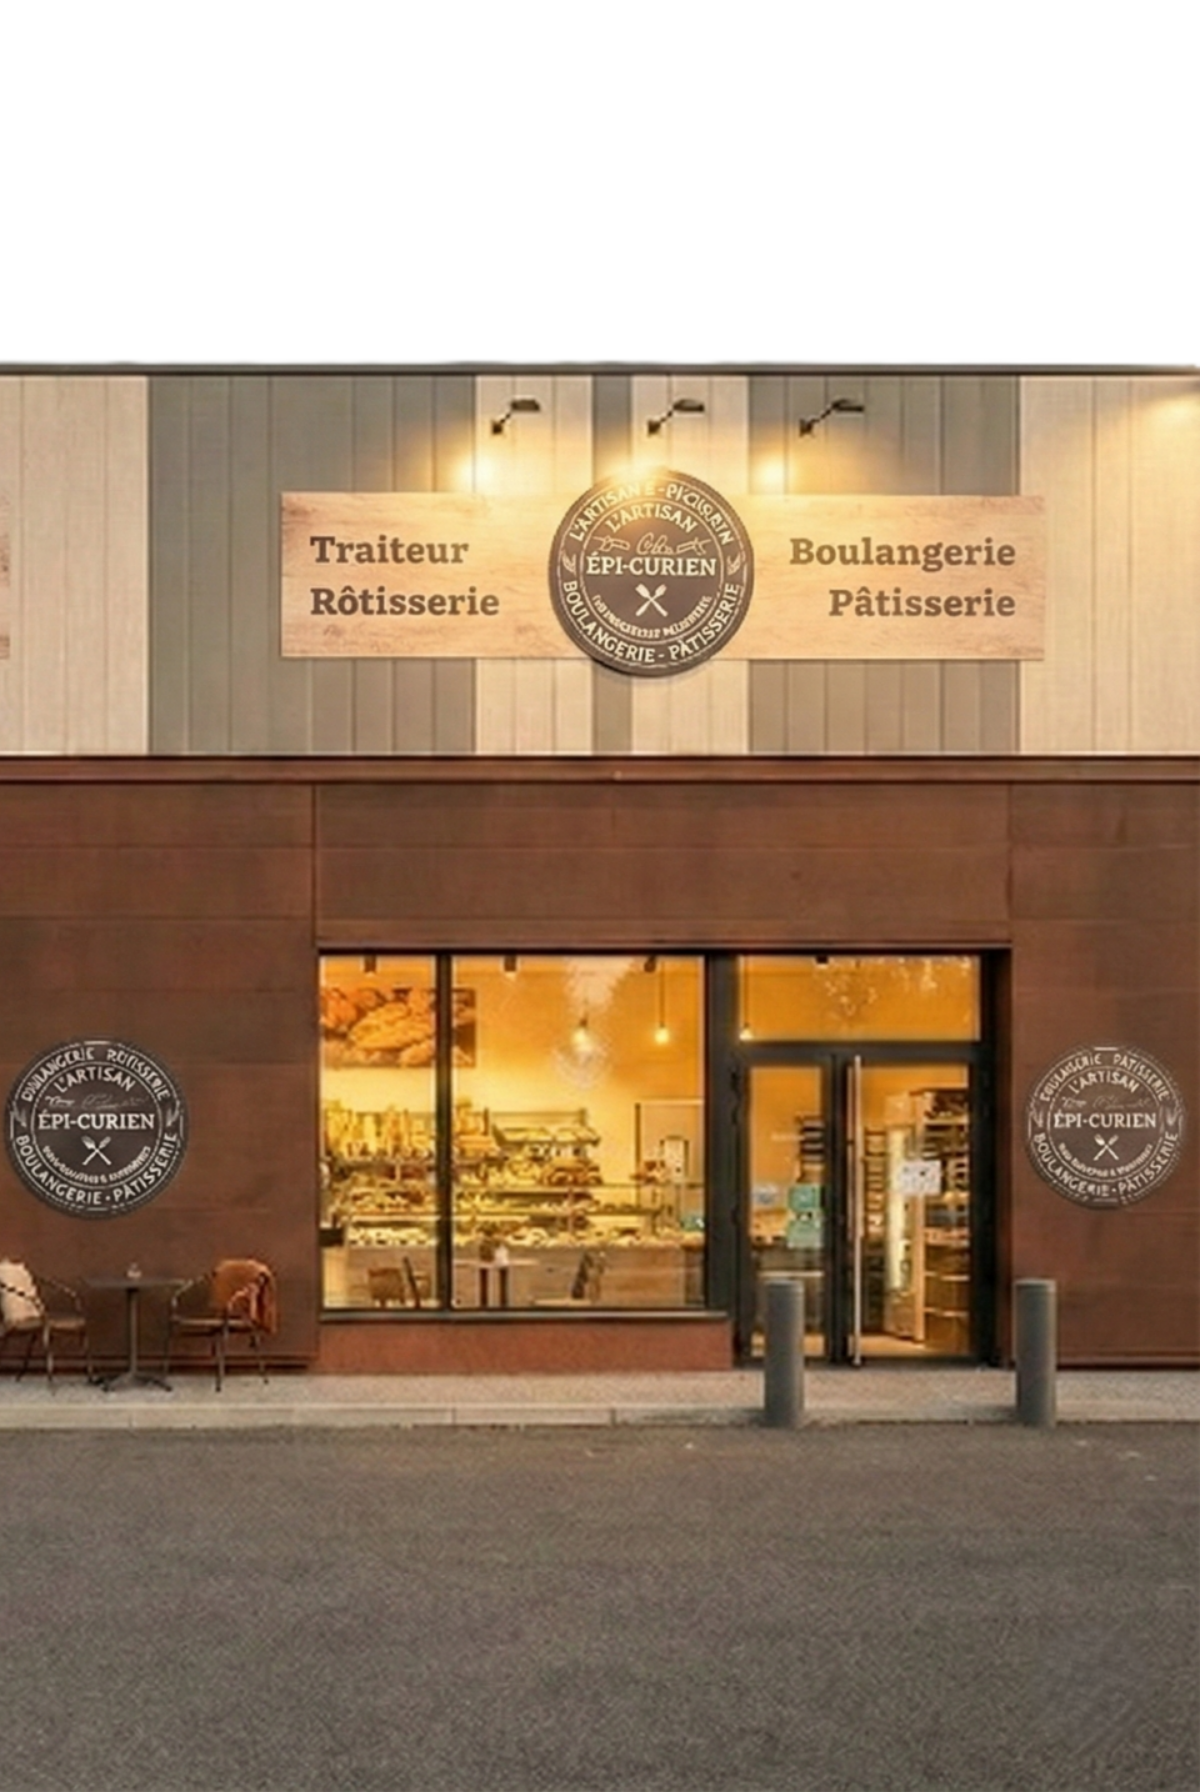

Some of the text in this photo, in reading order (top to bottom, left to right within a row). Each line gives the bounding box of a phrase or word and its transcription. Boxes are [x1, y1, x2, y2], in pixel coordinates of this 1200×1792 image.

[605, 503, 698, 533] L'ARTISAN
[310, 534, 469, 564] Traiteur
[586, 551, 716, 576] ÉPI-CURIEN
[789, 537, 1016, 573] Boulangerie
[310, 585, 500, 616] Rôtisserie
[829, 586, 1016, 617] Pâtisserie
[563, 580, 655, 663] BOULANGERIE
[53, 1066, 136, 1093] L'ARTISAN
[1068, 1070, 1140, 1094] L'ARTISAN
[38, 1108, 155, 1130] ÉPI-CURIEN
[16, 1134, 102, 1205] BOULANGERIE
